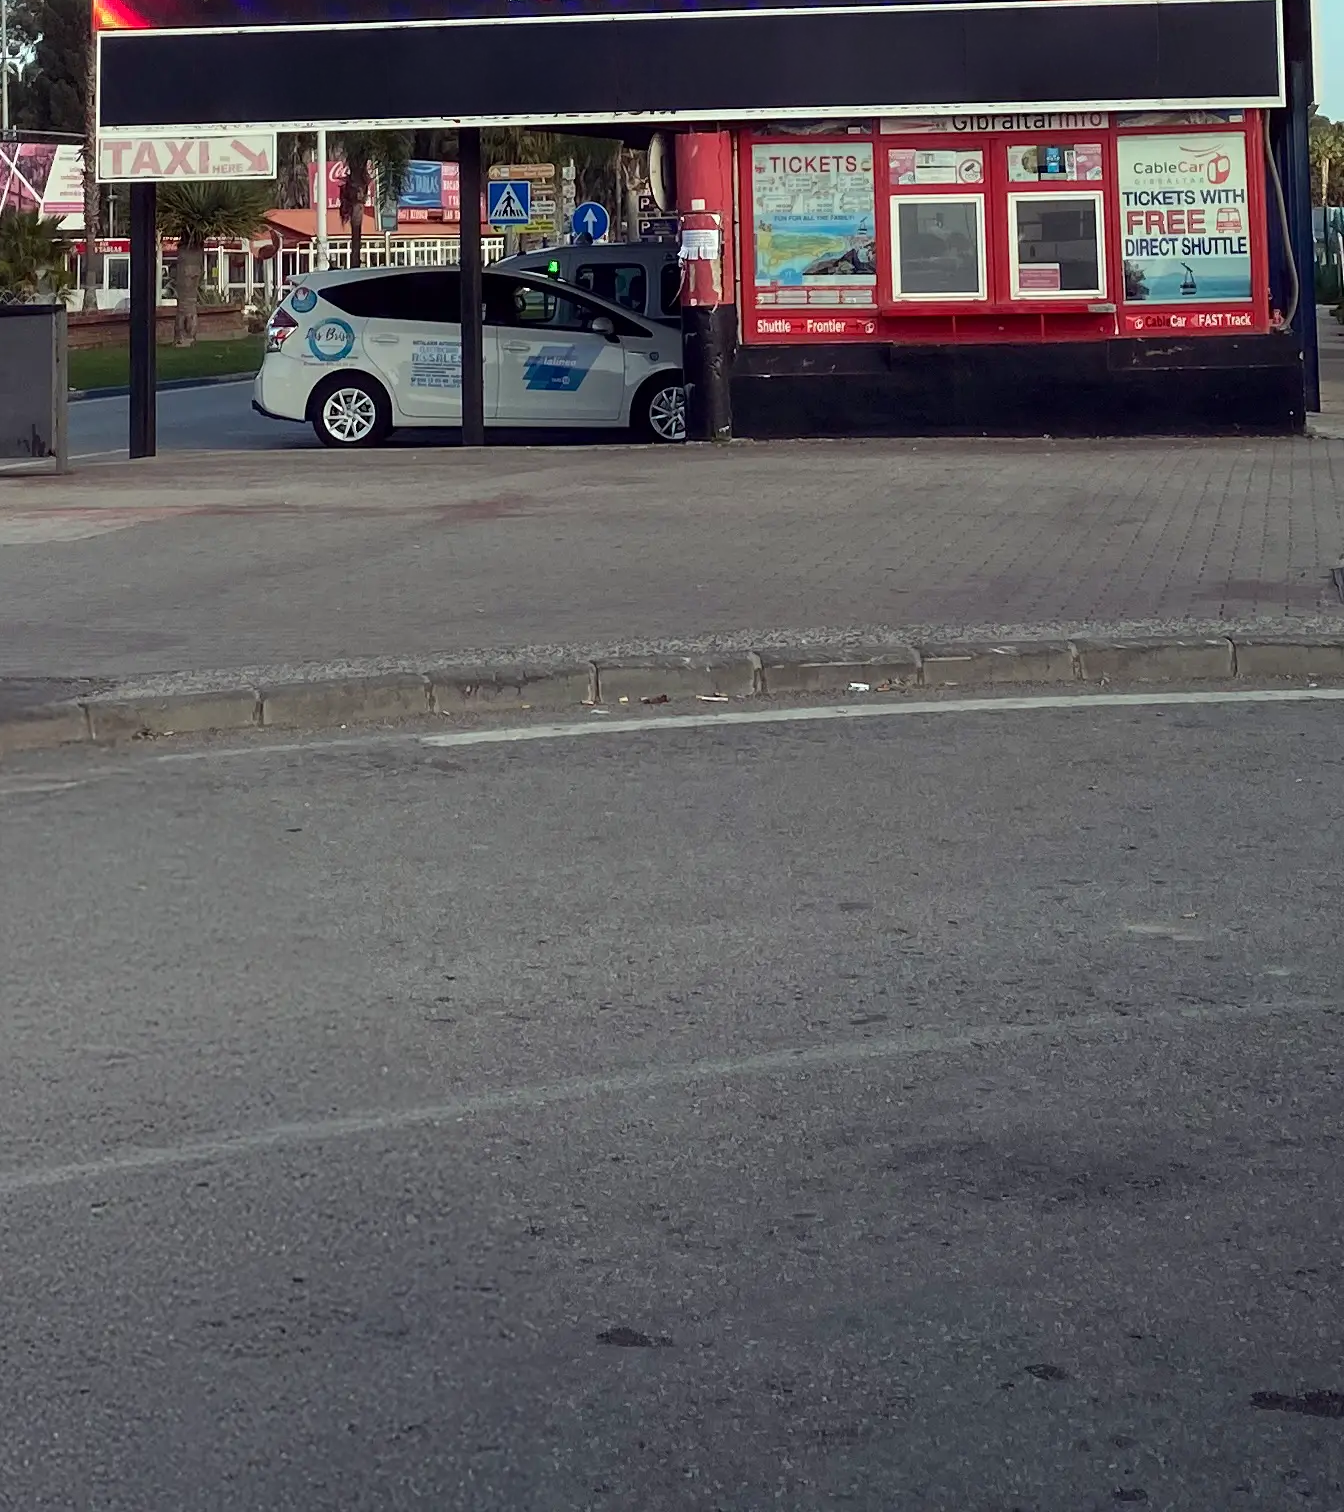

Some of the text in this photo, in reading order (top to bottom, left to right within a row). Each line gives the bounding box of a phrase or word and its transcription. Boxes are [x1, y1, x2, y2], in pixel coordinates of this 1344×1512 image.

[103, 140, 210, 176] TAXI
[769, 155, 858, 174] TICKETS
[1133, 160, 1205, 175] CableCar
[212, 162, 243, 175] HERE
[1122, 188, 1245, 207] TICKETS WITH
[1126, 208, 1207, 236] FREE
[1125, 236, 1248, 257] DIRECT SHUTTLE
[757, 318, 847, 334] Shuttle Frontier
[1145, 312, 1252, 328] CableCar FAST Track
